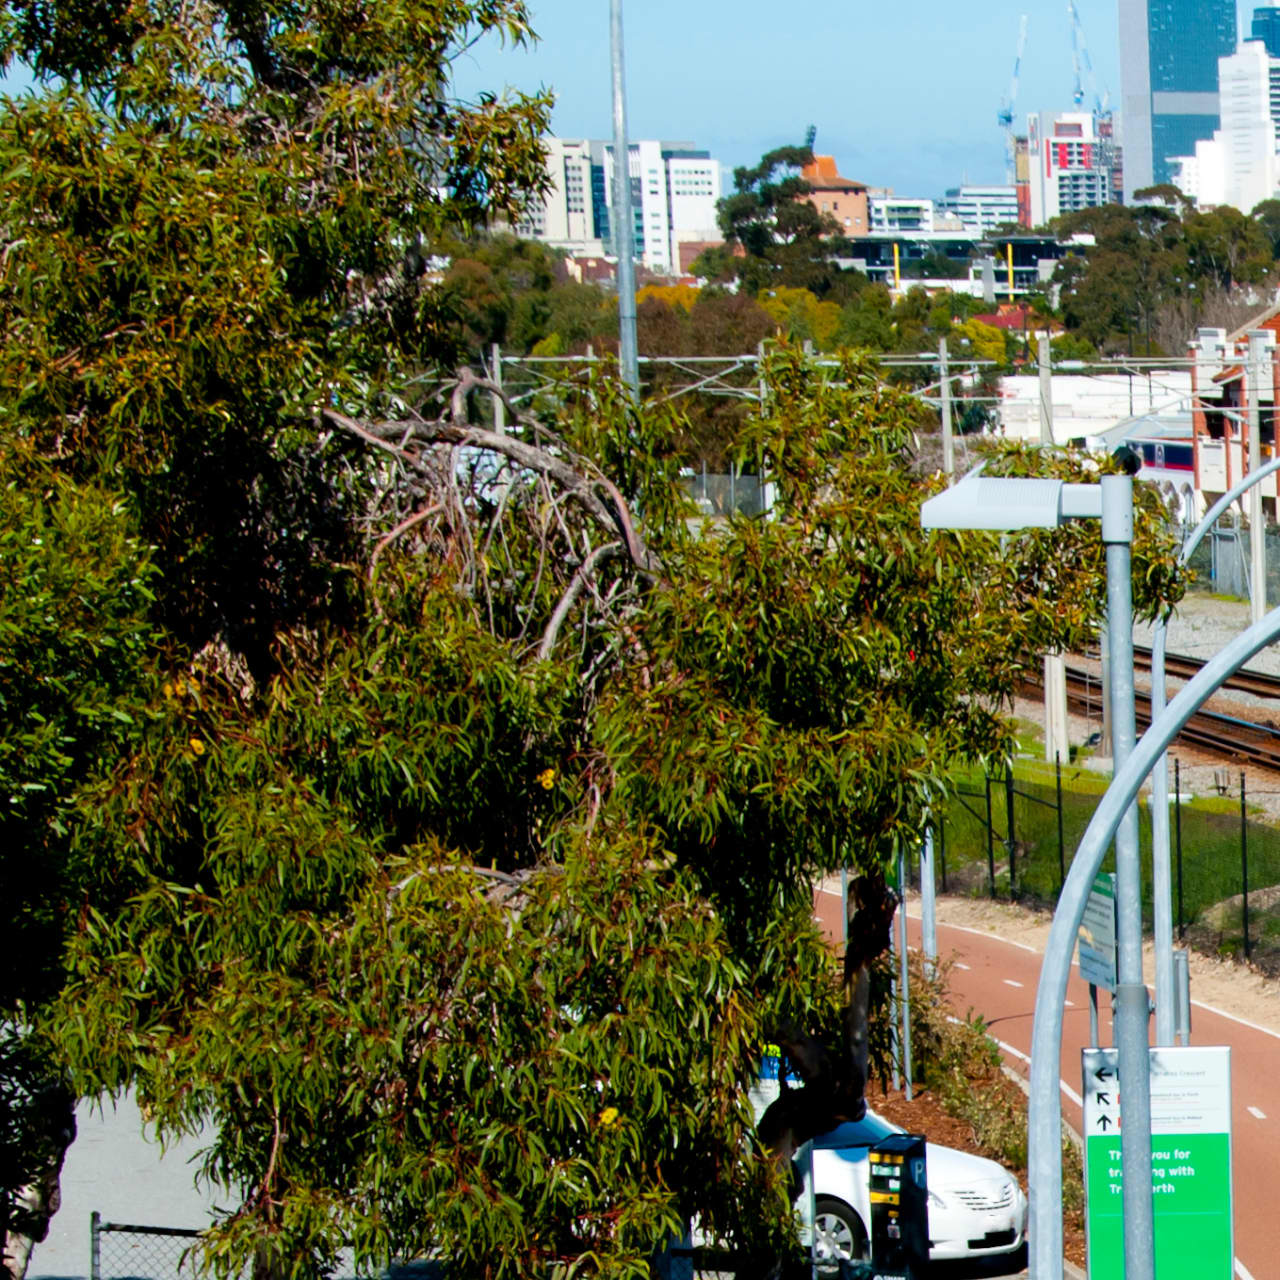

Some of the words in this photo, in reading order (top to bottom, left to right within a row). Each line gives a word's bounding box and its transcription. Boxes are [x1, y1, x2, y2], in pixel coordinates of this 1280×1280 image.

[1152, 1151, 1170, 1161] you
[1174, 1149, 1191, 1160] for
[915, 1160, 924, 1183] P
[1168, 1166, 1195, 1177] with
